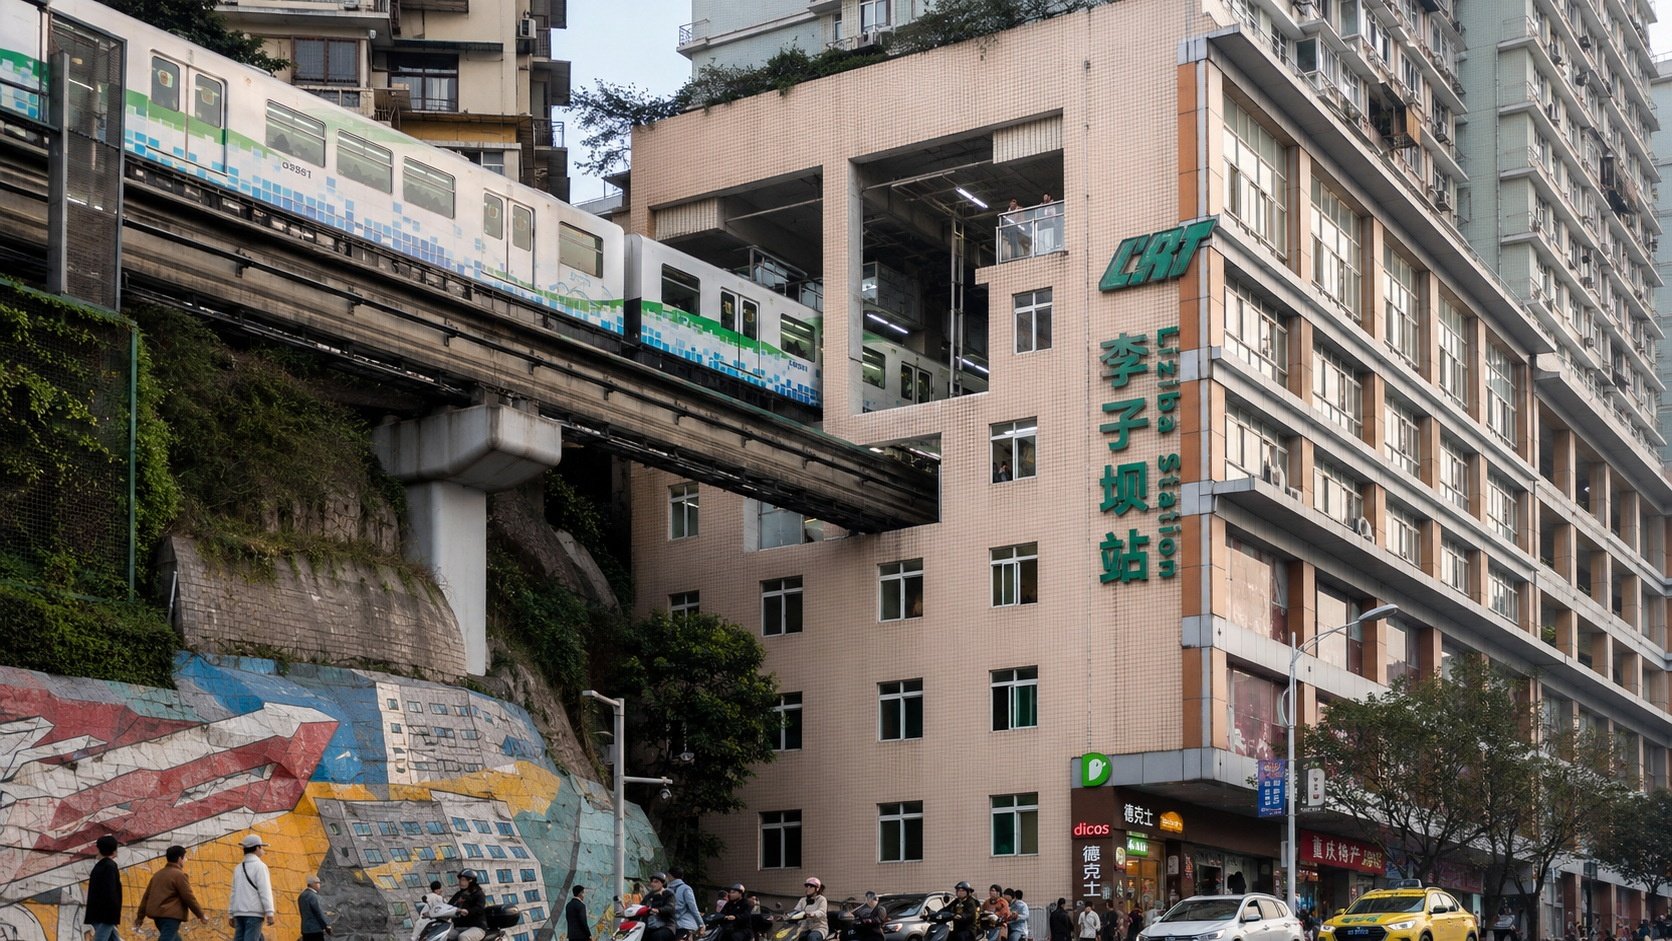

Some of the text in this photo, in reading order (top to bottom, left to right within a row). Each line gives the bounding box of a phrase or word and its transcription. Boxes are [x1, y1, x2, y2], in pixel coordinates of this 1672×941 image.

[1099, 219, 1217, 293] CRT
[1099, 332, 1149, 584] 李子坝站
[1157, 325, 1182, 577] Liziba Station
[1073, 822, 1110, 836] dicos
[1082, 845, 1101, 897] 德克士
